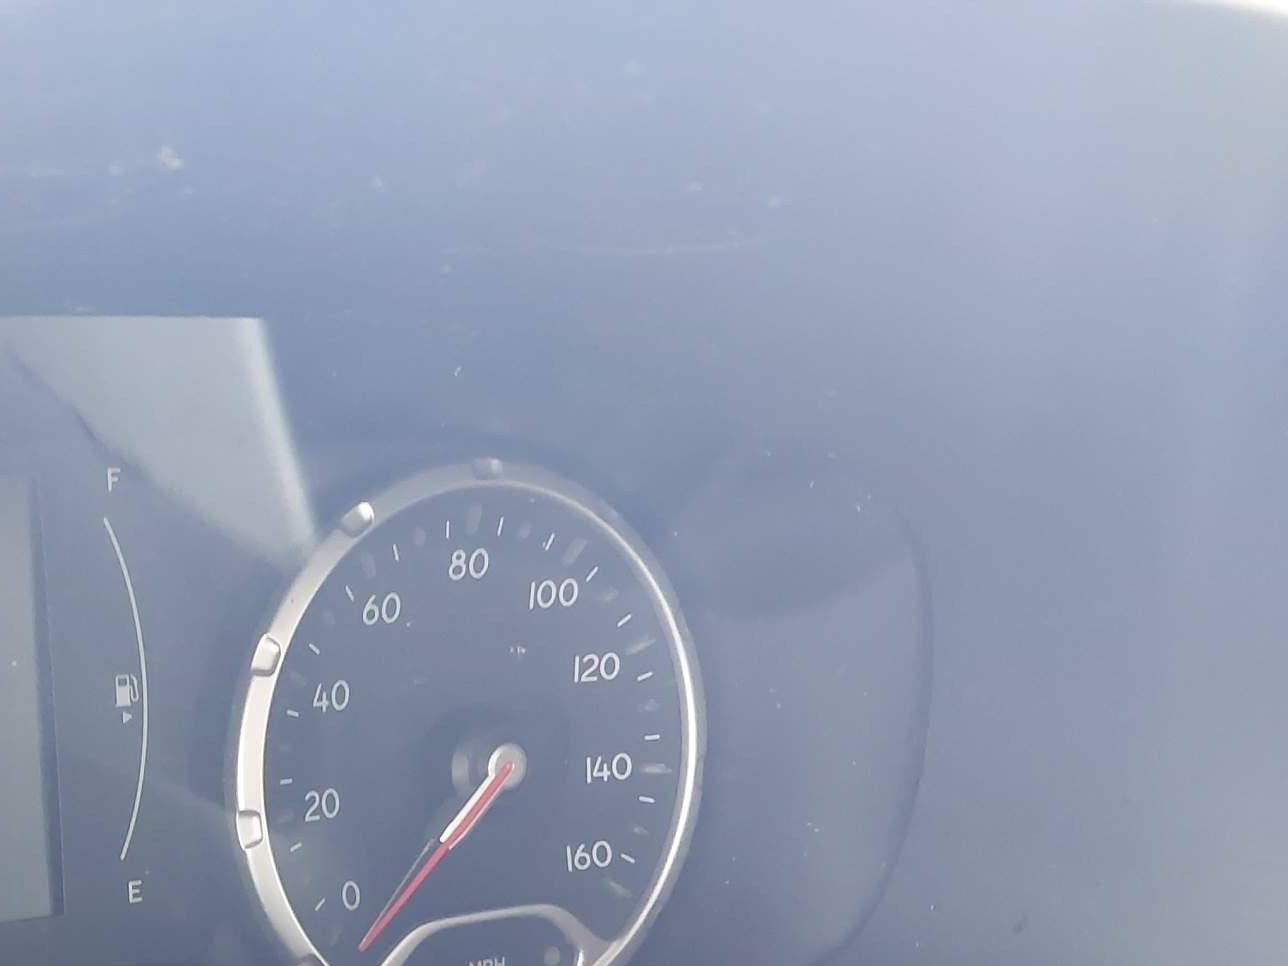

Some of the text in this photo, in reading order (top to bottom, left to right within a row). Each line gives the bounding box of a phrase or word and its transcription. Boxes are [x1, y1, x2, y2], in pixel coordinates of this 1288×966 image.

[106, 467, 121, 493] F
[448, 548, 489, 580] 80
[362, 591, 401, 626] 60
[528, 577, 579, 610] 100
[573, 651, 621, 684] 120
[312, 679, 350, 712] 40
[585, 752, 633, 782] 140
[304, 787, 340, 821] 20
[565, 839, 613, 872] 160
[126, 879, 143, 904] E
[342, 880, 361, 911] 0
